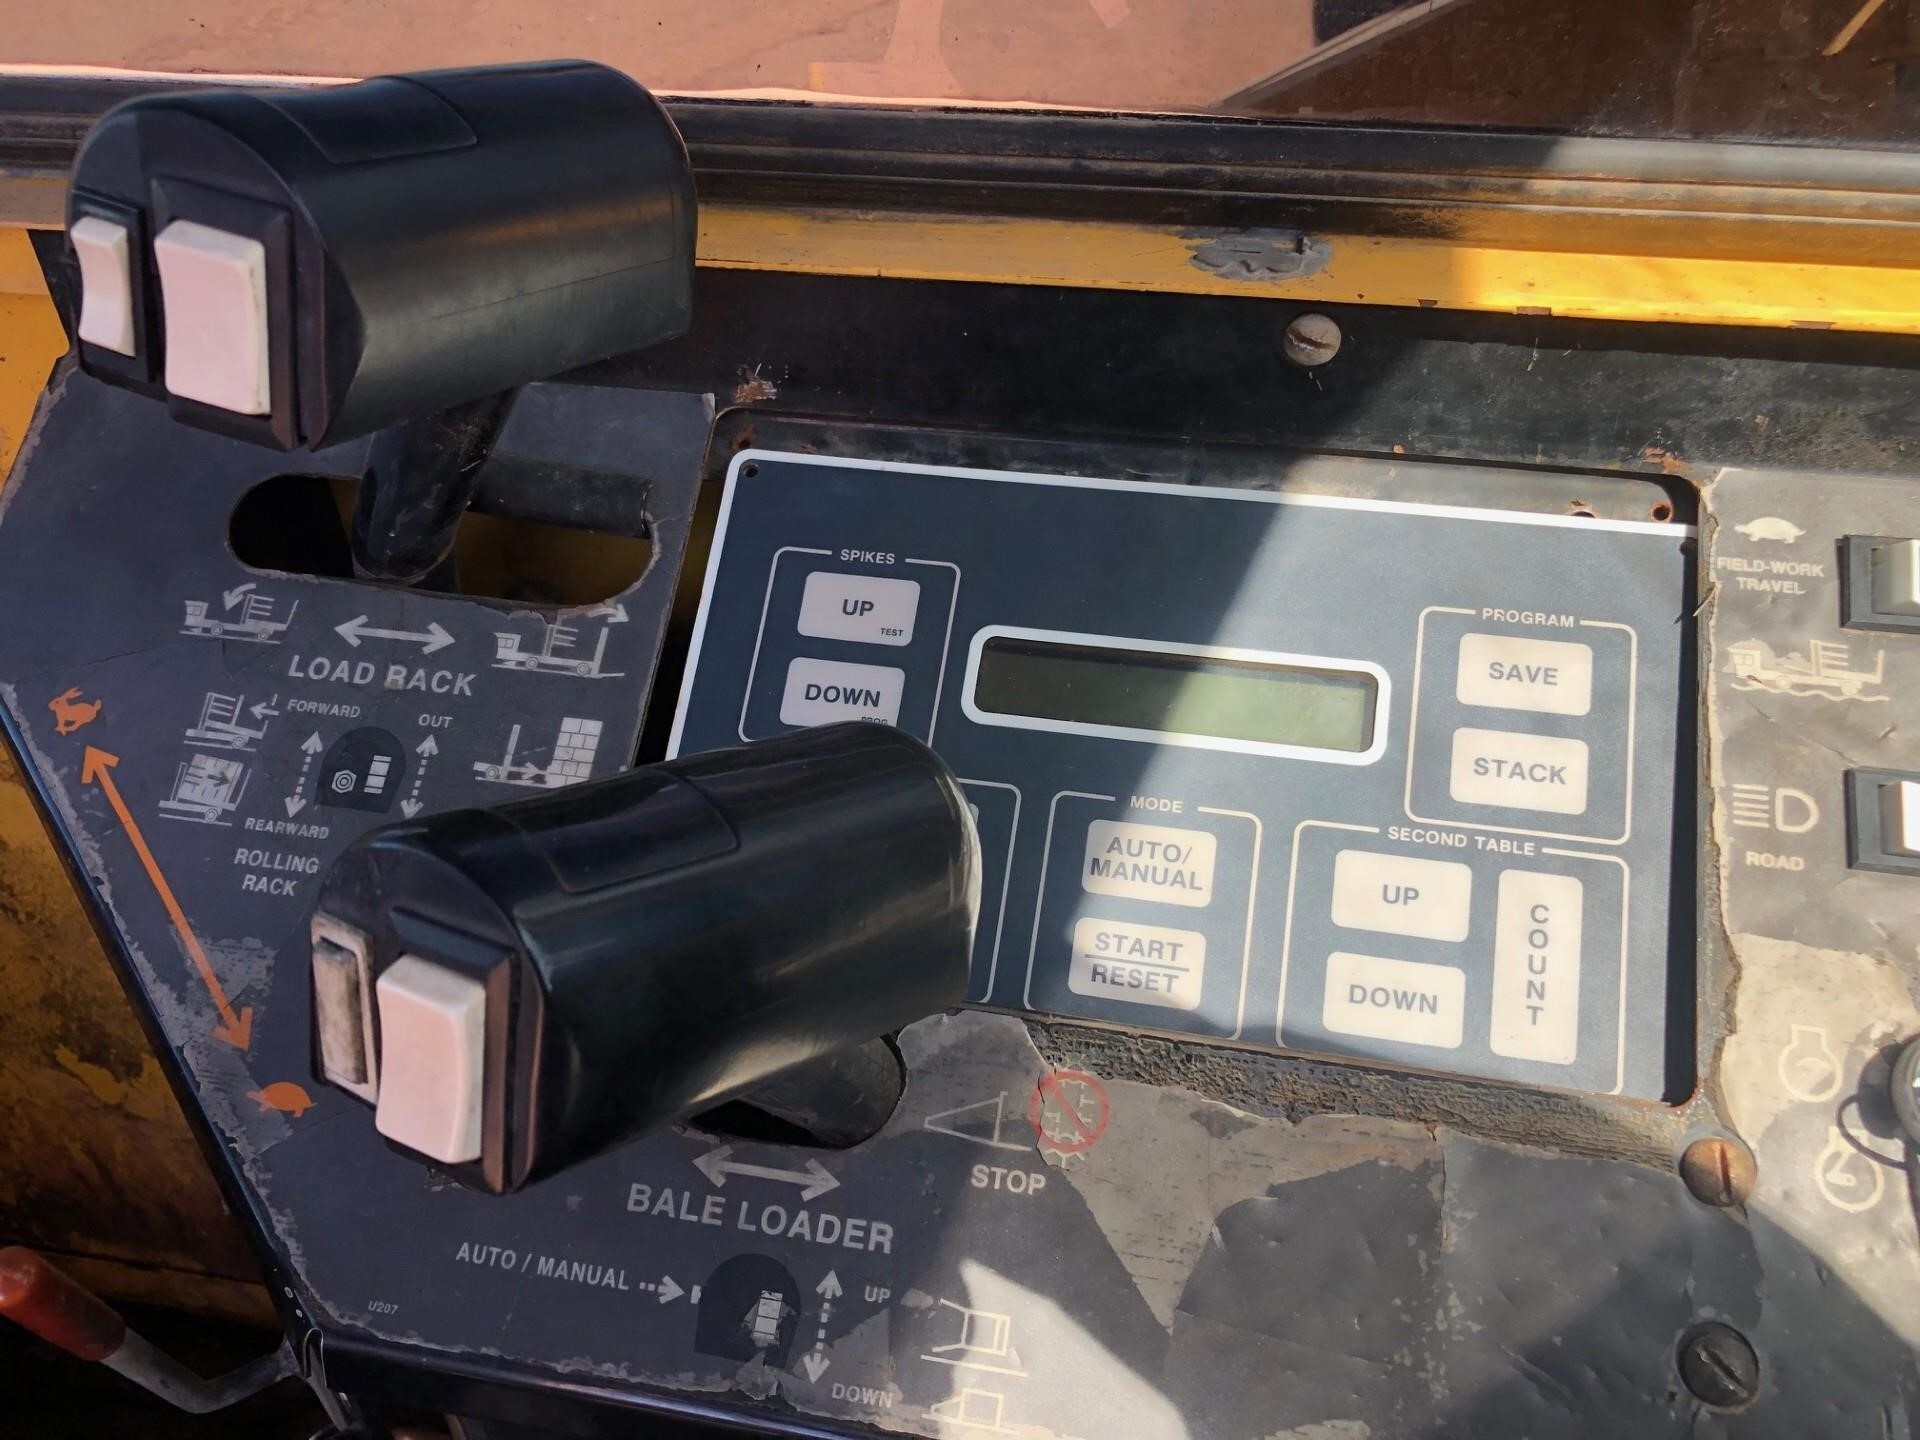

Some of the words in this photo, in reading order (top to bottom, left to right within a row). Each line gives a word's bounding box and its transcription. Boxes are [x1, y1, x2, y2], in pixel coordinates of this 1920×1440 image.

[839, 548, 896, 566] SPIKES
[1717, 557, 1823, 578] FIELD-WORK
[1736, 577, 1806, 595] TRAVEL
[841, 597, 875, 618] UP
[1482, 607, 1574, 629] PROGRAM
[880, 627, 904, 638] TEST
[288, 655, 374, 685] LOAD
[385, 665, 477, 697] RACK
[1488, 661, 1559, 687] SAVE
[804, 683, 881, 708] DOWN
[287, 698, 361, 719] FORWARD
[418, 713, 453, 729] OUT
[1473, 757, 1567, 786] STACK
[1130, 795, 1184, 814] MODE
[244, 816, 330, 840] REARWARD
[1387, 825, 1468, 848] SECOND
[1474, 835, 1536, 856] TABLE
[233, 847, 319, 875] ROLLING
[1107, 836, 1193, 865] AUTO/
[1745, 850, 1806, 871] ROAD
[241, 873, 297, 896] RACK
[1090, 857, 1204, 891] MANUAL
[1381, 883, 1421, 907] UP
[1095, 932, 1184, 961] START
[1526, 903, 1551, 1026] COUNT
[1091, 963, 1179, 993] RESET
[1347, 983, 1438, 1015] DOWN
[971, 1165, 1047, 1196] STOP
[627, 1183, 726, 1227] BALE
[736, 1200, 895, 1255] LOADER
[455, 1242, 517, 1270] AUTO
[536, 1258, 630, 1292] MANUAL
[863, 1285, 891, 1304] UP
[367, 1301, 399, 1315] U207
[831, 1382, 893, 1409] DOWN
